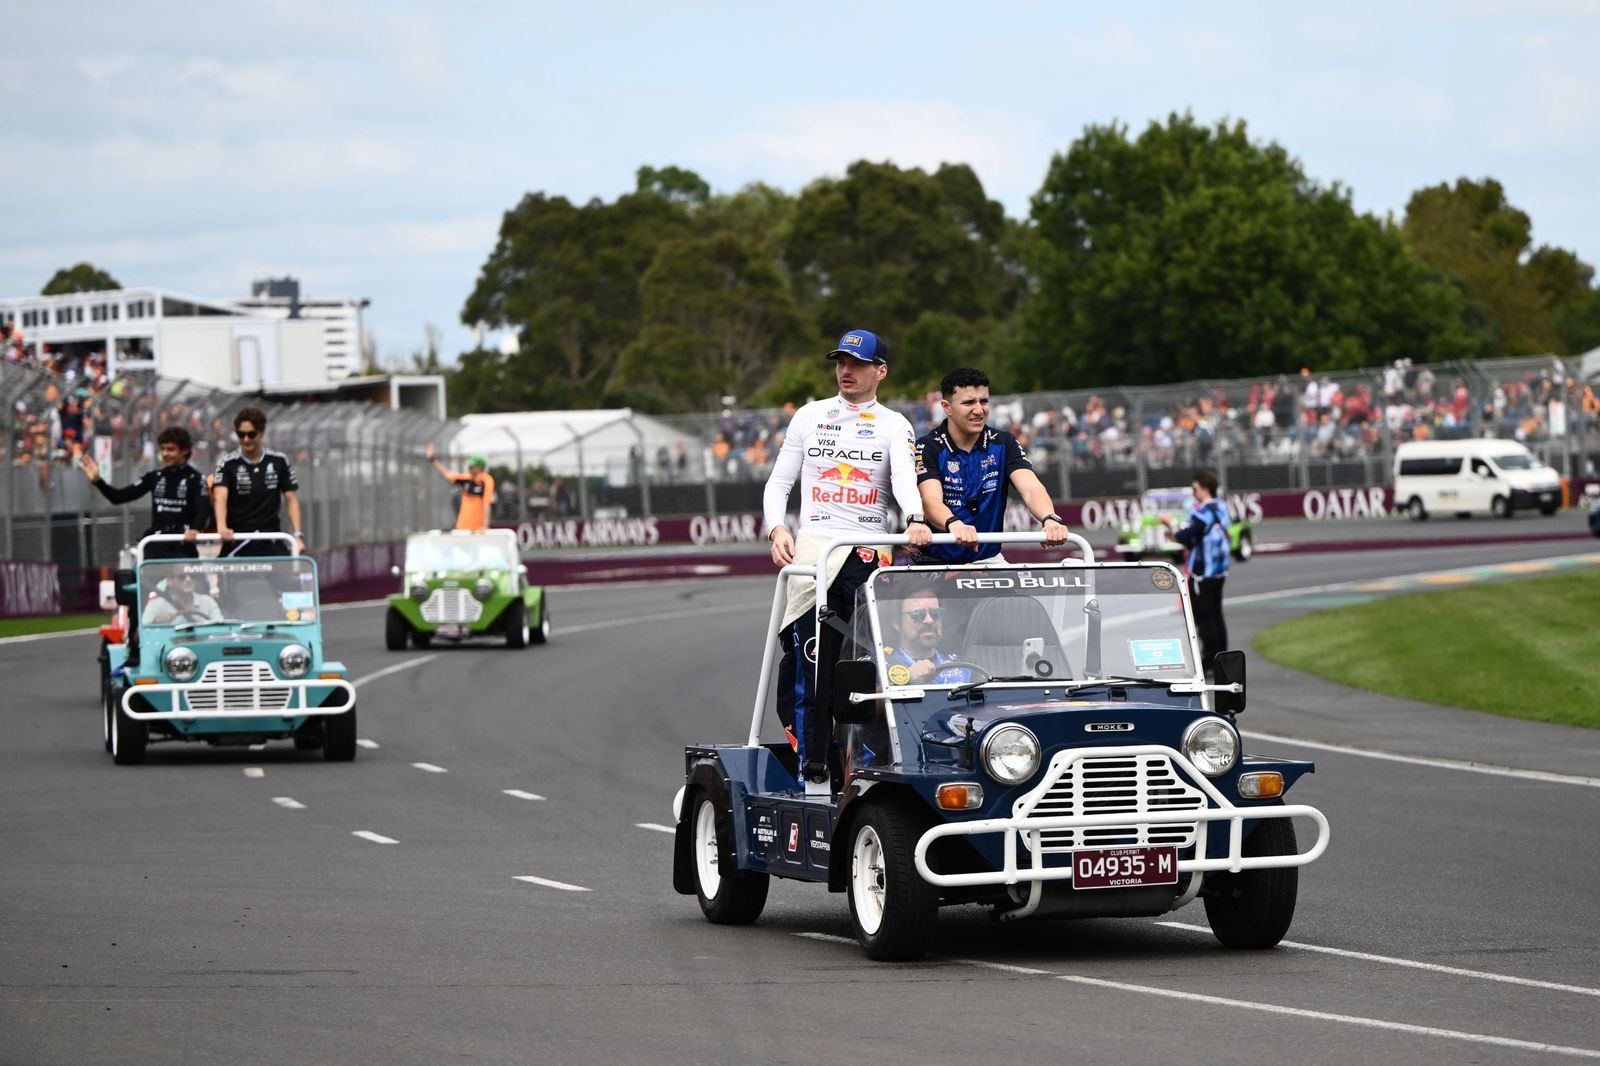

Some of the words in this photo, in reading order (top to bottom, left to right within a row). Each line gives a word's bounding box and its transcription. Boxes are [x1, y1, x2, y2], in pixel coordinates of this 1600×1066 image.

[808, 447, 883, 461] ORACLE
[812, 486, 844, 503] Red
[846, 487, 879, 505] Bull
[1303, 487, 1387, 520] QATAR
[517, 521, 579, 551] QATAR
[581, 516, 660, 546] AIRWAYS
[689, 514, 757, 545] QATAR
[183, 563, 274, 574] MERCEDES
[955, 577, 1015, 590] RED
[1020, 576, 1092, 589] BULL
[1097, 723, 1125, 731] MOKE
[1109, 878, 1143, 886] VICTORIA
